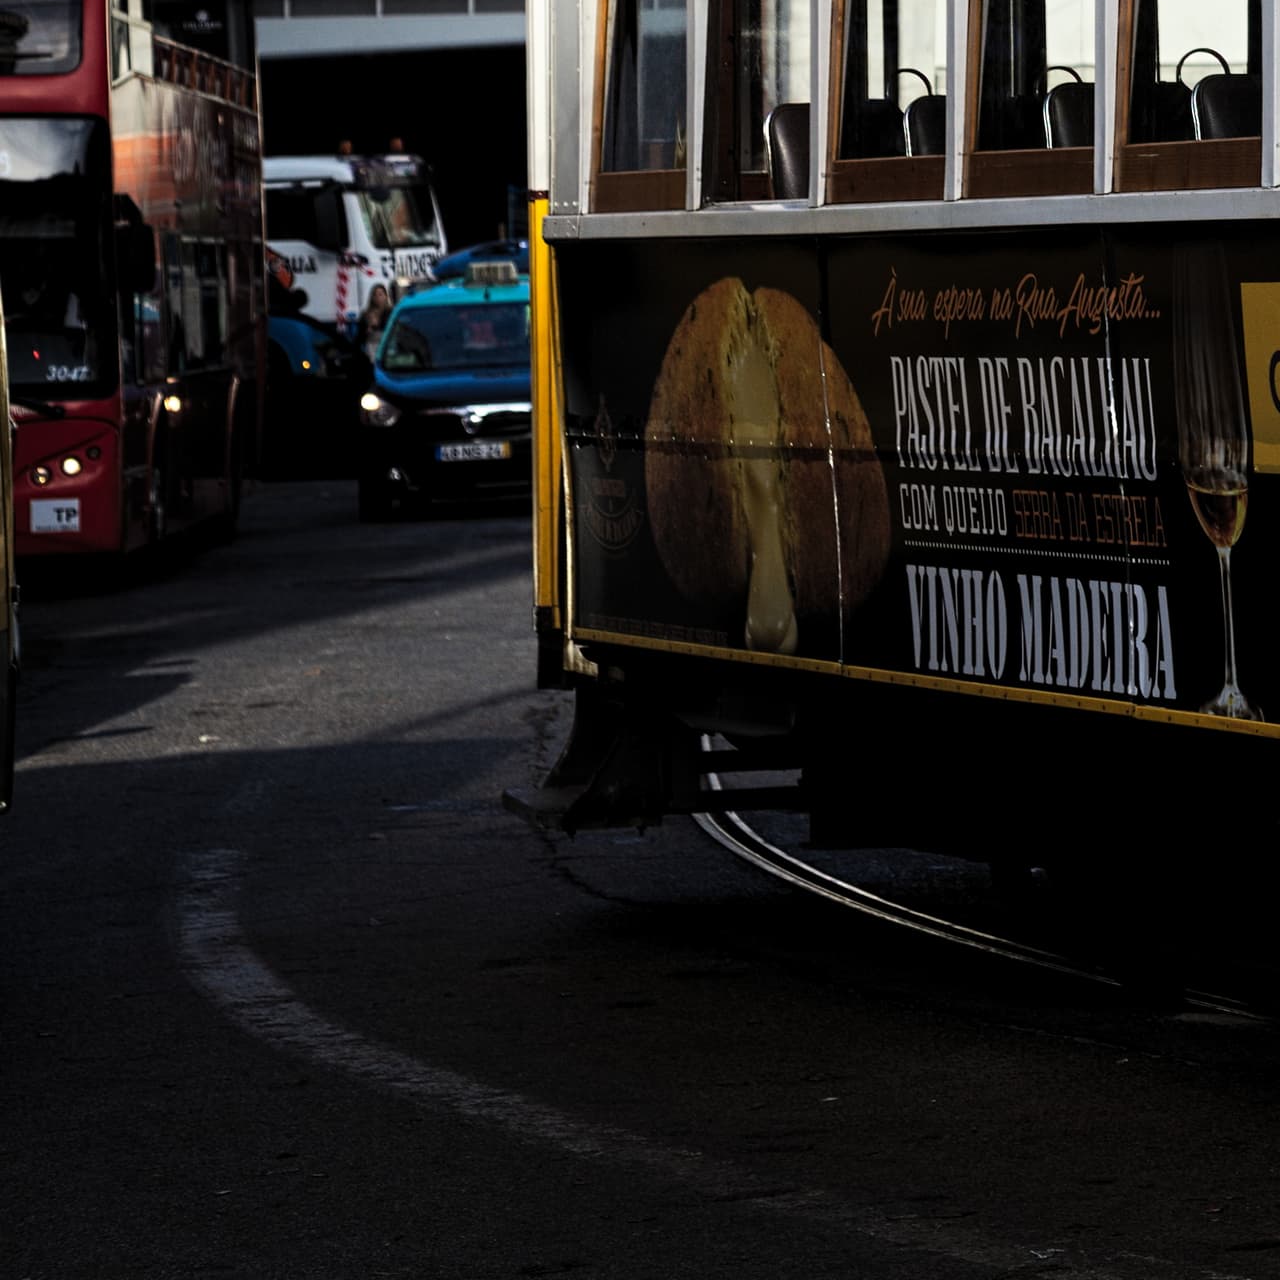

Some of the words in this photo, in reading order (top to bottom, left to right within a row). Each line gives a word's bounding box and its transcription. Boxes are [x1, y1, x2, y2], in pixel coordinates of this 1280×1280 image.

[872, 266, 898, 337] À
[897, 287, 930, 322] sua
[933, 283, 987, 340] espera
[990, 287, 1015, 321] na
[1014, 272, 1060, 339] Rua
[890, 354, 982, 472] PASTEL
[978, 356, 1019, 473] DE
[1016, 355, 1158, 481] BACALHAU
[900, 483, 939, 531] COM
[942, 486, 1008, 536] QUEIJO
[1012, 489, 1064, 540] SERRA
[1065, 492, 1090, 541] DA
[1092, 493, 1168, 548] ESTRELA
[906, 564, 1008, 680] VINHO
[1016, 573, 1177, 699] MADEIRA
